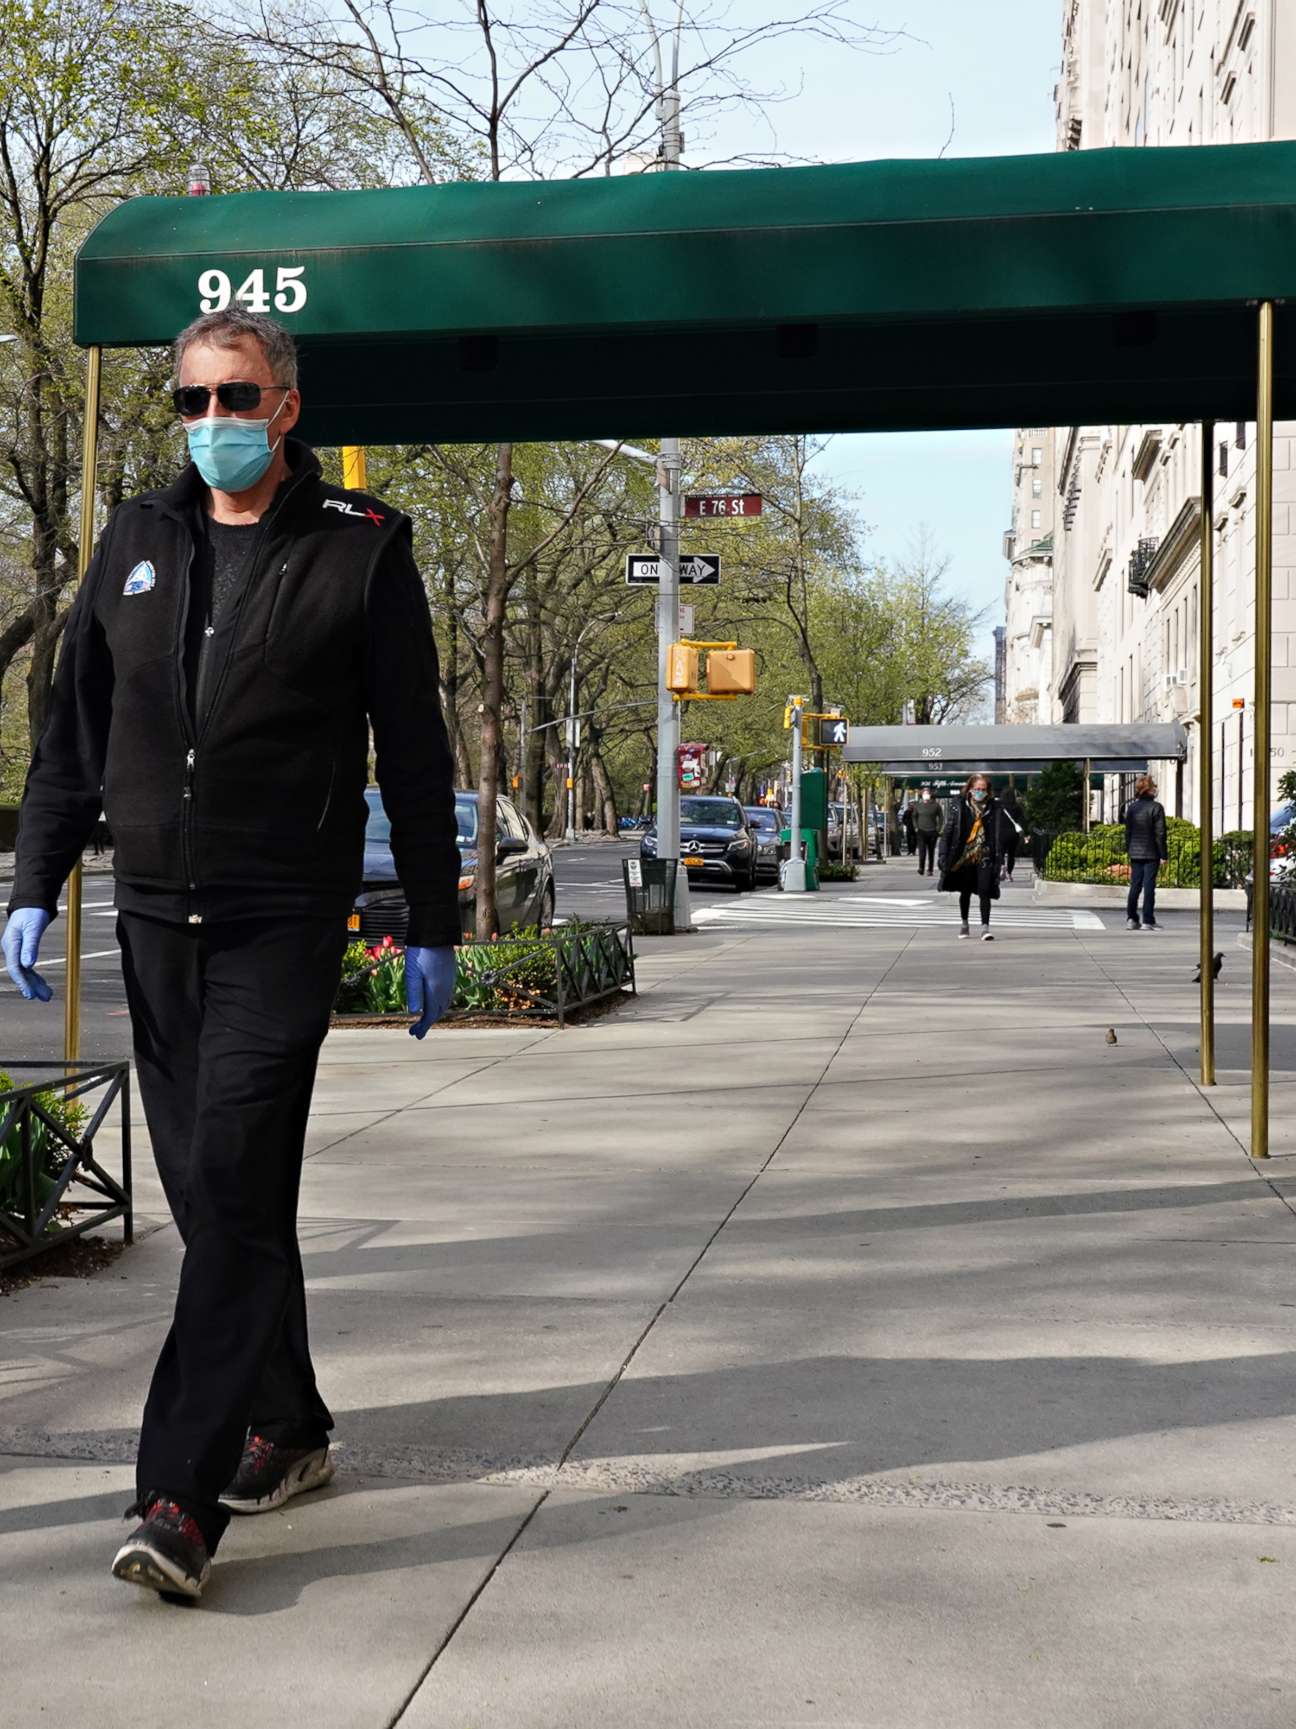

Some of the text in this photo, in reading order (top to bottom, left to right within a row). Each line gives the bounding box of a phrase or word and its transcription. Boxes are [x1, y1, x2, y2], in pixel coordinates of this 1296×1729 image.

[198, 266, 307, 314] 945
[322, 499, 385, 528] RLX
[699, 499, 744, 515] E 76 St
[641, 564, 706, 576] ON WAY
[921, 747, 943, 757] 952
